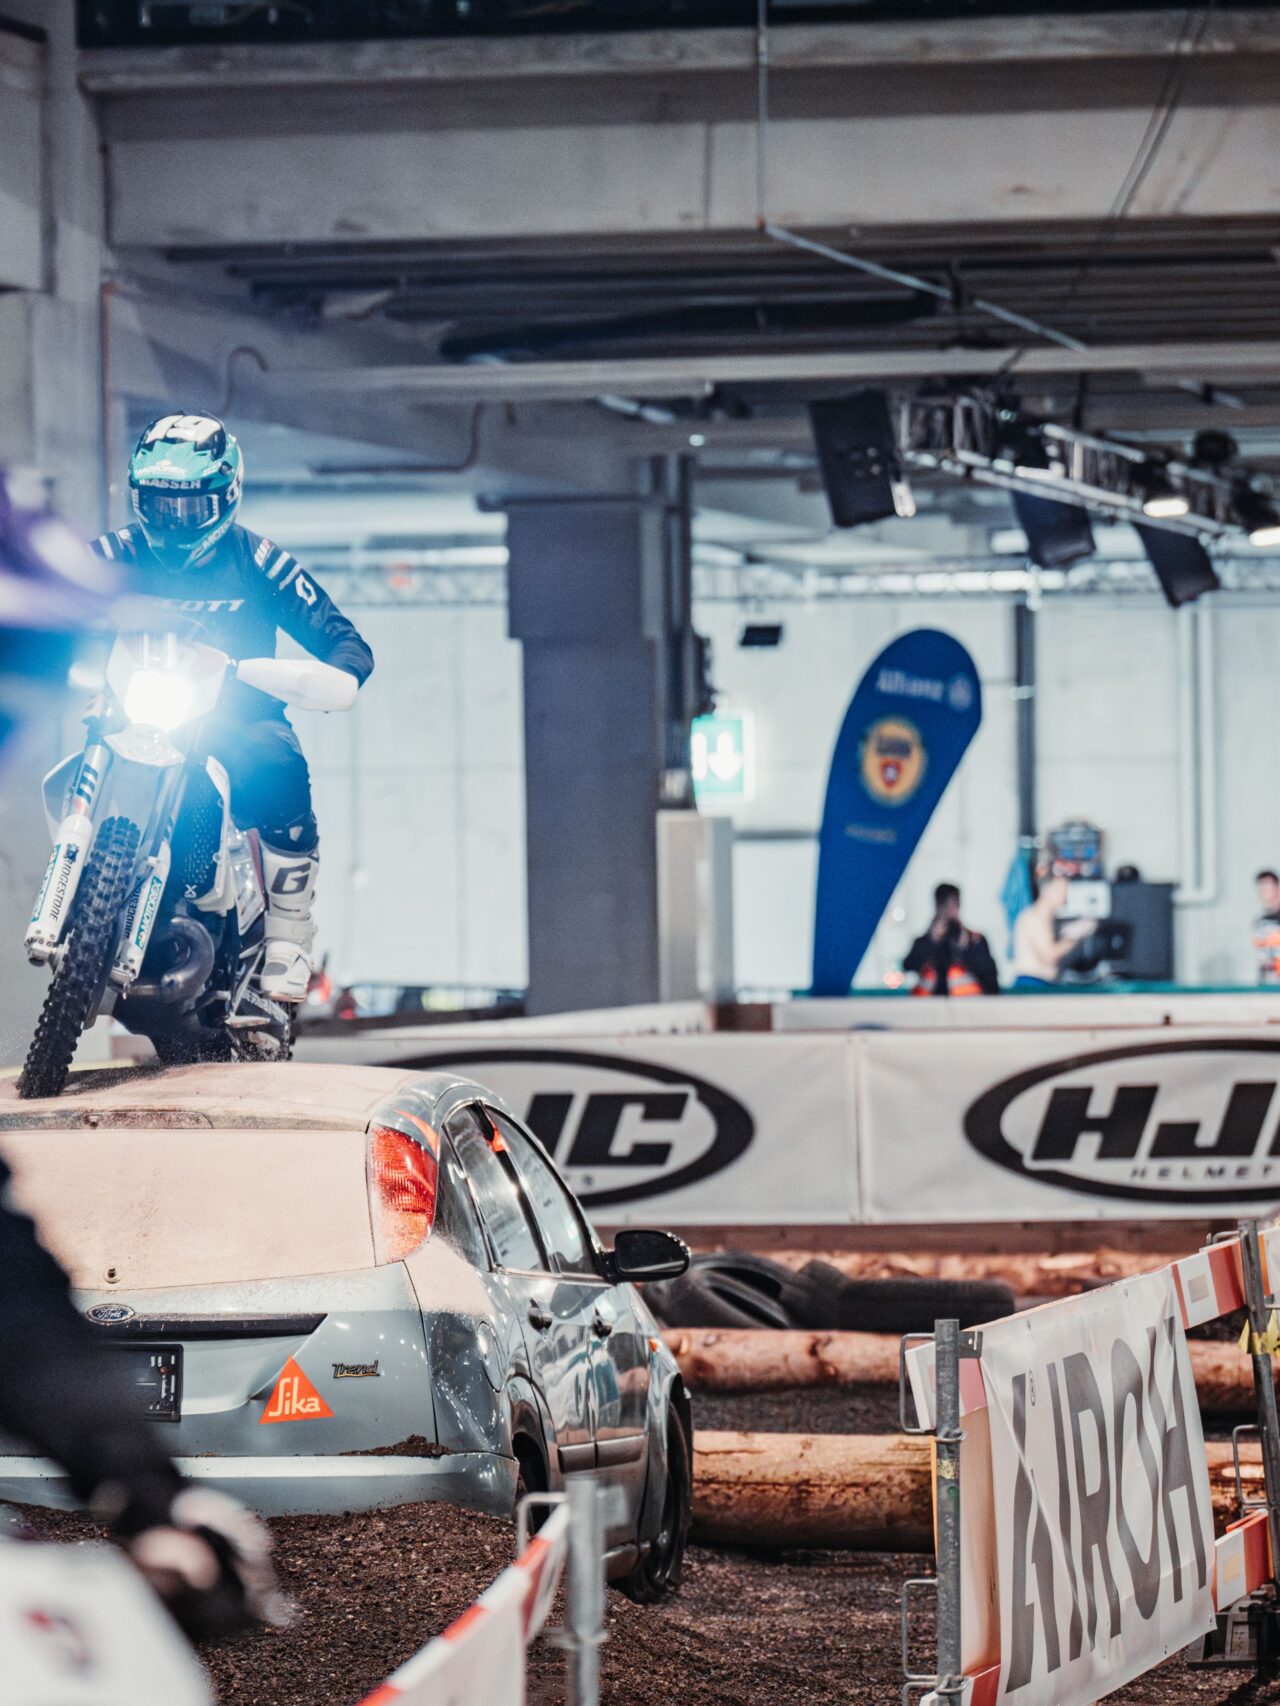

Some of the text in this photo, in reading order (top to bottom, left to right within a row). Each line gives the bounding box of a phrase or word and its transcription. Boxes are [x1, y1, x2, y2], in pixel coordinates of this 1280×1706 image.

[47, 848, 76, 922] RIDGESTONE
[271, 862, 312, 895] G
[1031, 1082, 1280, 1161] HJ
[96, 1307, 123, 1320] Ford
[331, 1359, 381, 1379] Trend
[268, 1376, 321, 1418] Sika
